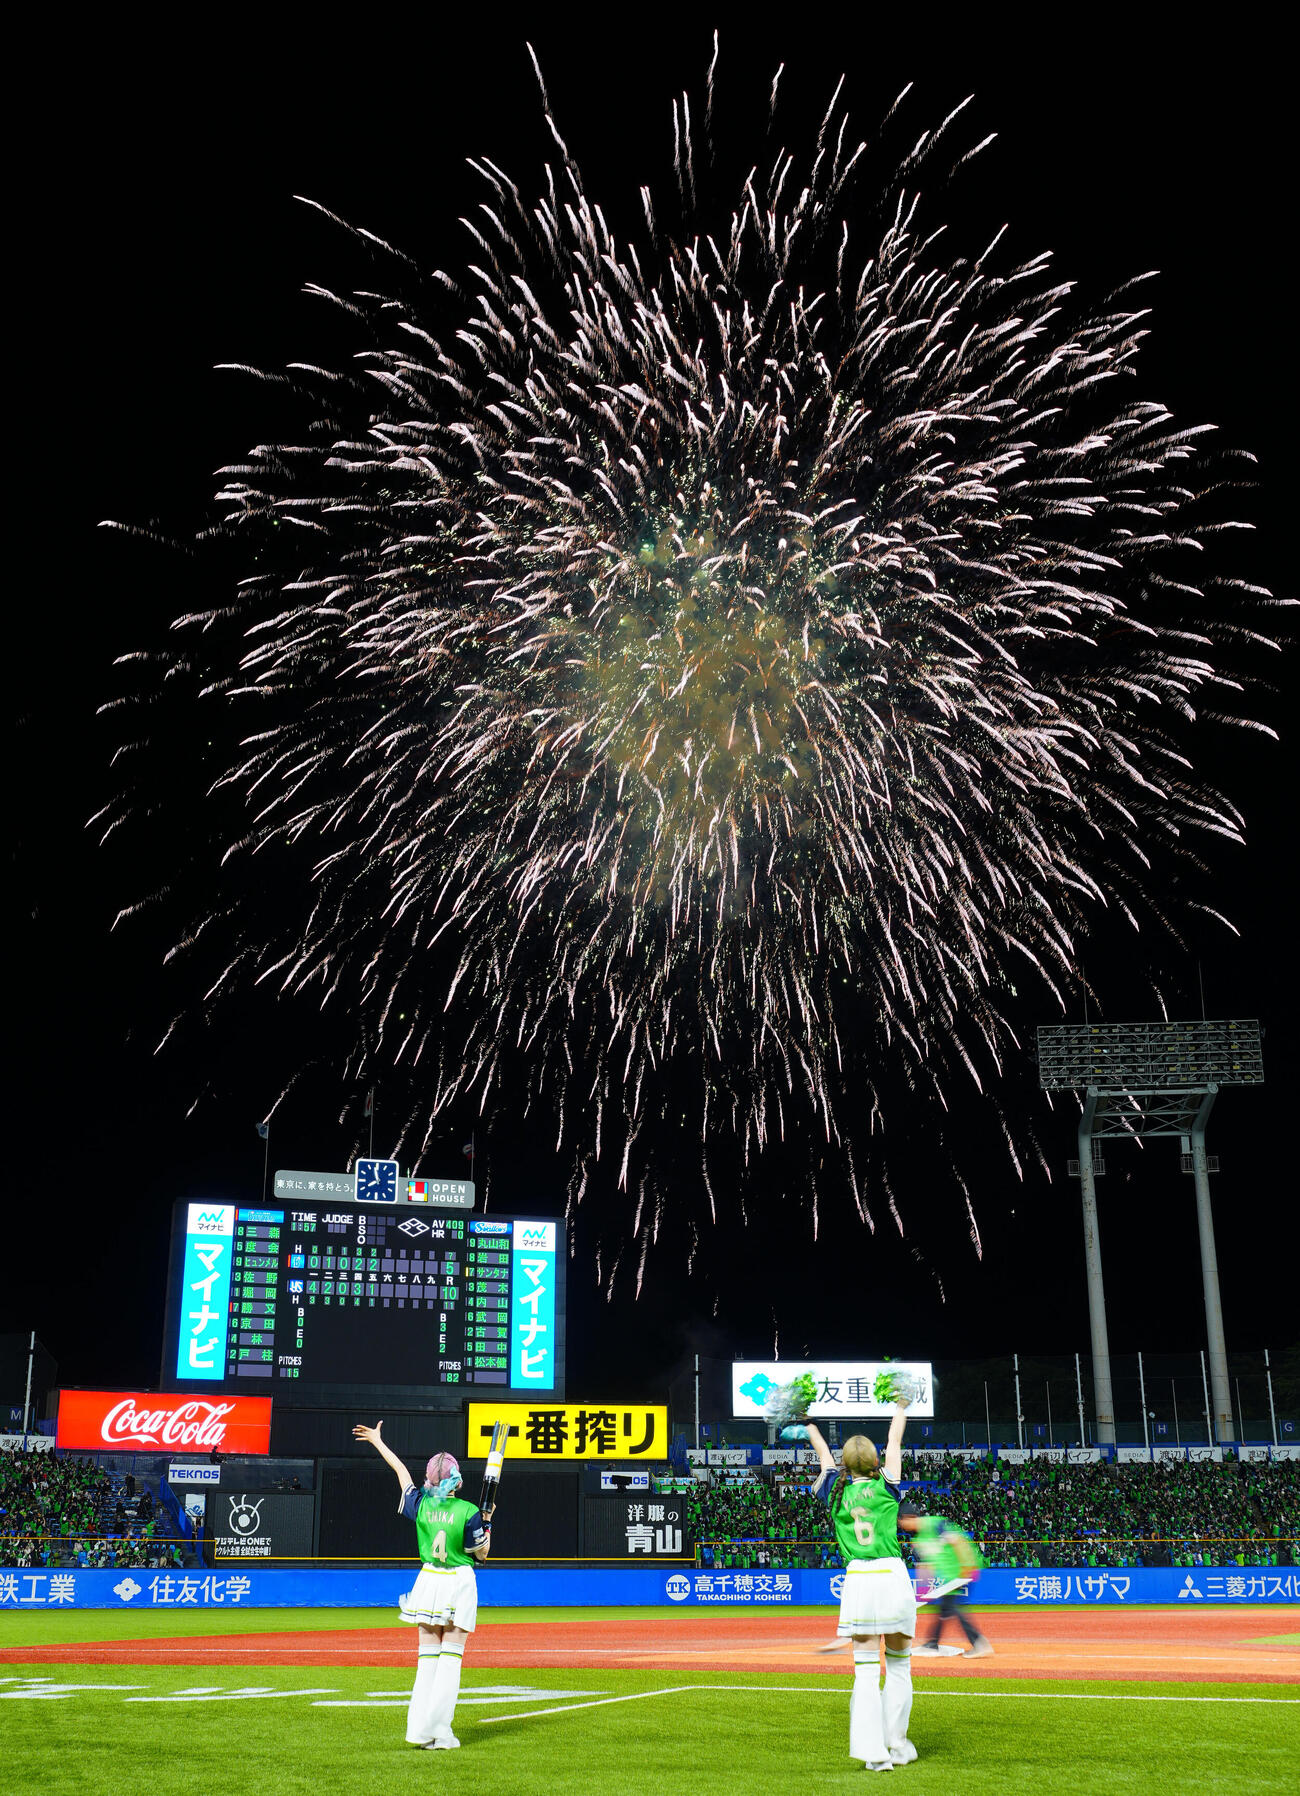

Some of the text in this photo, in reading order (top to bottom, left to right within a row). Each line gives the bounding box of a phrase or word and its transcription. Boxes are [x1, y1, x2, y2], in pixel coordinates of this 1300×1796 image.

[432, 1183, 466, 1194] OPEN
[432, 1194, 465, 1204] HOUSE
[291, 1211, 353, 1225] TIME JUDGE
[358, 1215, 367, 1225] B
[432, 1219, 445, 1229] AV
[238, 1226, 244, 1236] 8
[358, 1224, 366, 1235] S
[432, 1230, 445, 1238] HR
[237, 1241, 243, 1251] 5
[470, 1238, 476, 1247] 9
[295, 1244, 302, 1254] H
[236, 1257, 242, 1266] 9
[469, 1253, 475, 1262] 8
[310, 1256, 318, 1268] 0
[327, 1256, 332, 1268] 1
[340, 1257, 348, 1269] 0
[355, 1258, 362, 1270] 2
[369, 1259, 377, 1271] 2
[446, 1262, 454, 1274] 5
[235, 1272, 241, 1281] 3
[469, 1267, 508, 1278] 7 サンタナ
[339, 1272, 348, 1280] 三
[368, 1273, 377, 1282] 五
[383, 1274, 392, 1282] 六
[398, 1274, 407, 1283] 七
[412, 1275, 421, 1283] 八
[427, 1275, 436, 1284] 九
[446, 1276, 454, 1286] R
[309, 1281, 316, 1293] 4
[324, 1282, 332, 1294] 2
[338, 1282, 346, 1294] 0
[354, 1283, 361, 1295] 3
[370, 1284, 374, 1296] 1
[442, 1286, 456, 1300] 10
[468, 1282, 474, 1291] 3
[234, 1288, 239, 1296] 1
[292, 1294, 299, 1304] H
[468, 1297, 474, 1306] 4
[188, 1242, 225, 1369] マイナビ
[233, 1303, 239, 1312] 7
[298, 1308, 304, 1316] B
[467, 1312, 474, 1321] 6
[440, 1313, 447, 1322] B
[519, 1258, 548, 1378] マイナビ
[232, 1319, 238, 1328] 6
[440, 1323, 446, 1332] 3
[296, 1329, 304, 1338] E
[467, 1327, 473, 1336] 2
[231, 1334, 237, 1343] 4
[440, 1334, 446, 1343] E
[440, 1344, 446, 1353] 2
[467, 1342, 473, 1351] 5
[230, 1350, 236, 1359] 2
[278, 1356, 302, 1365] PITCHES
[467, 1358, 472, 1366] 1
[439, 1361, 461, 1370] PITCHES
[288, 1368, 299, 1378] 15
[447, 1373, 459, 1382] 82
[1158, 1424, 1166, 1433] H
[1284, 1423, 1293, 1432] G
[480, 1410, 655, 1455] 一番搾り
[170, 1469, 219, 1479] TEKNOS
[627, 1504, 679, 1522] 洋服の
[851, 1506, 875, 1546] 6
[625, 1524, 682, 1553] 青山
[432, 1529, 448, 1562] 4
[694, 1574, 793, 1592] 高千穂交易
[1014, 1573, 1130, 1600] 安藤ハザマ
[0, 1574, 76, 1604] 鉄工業
[148, 1575, 250, 1603] 住友化学
